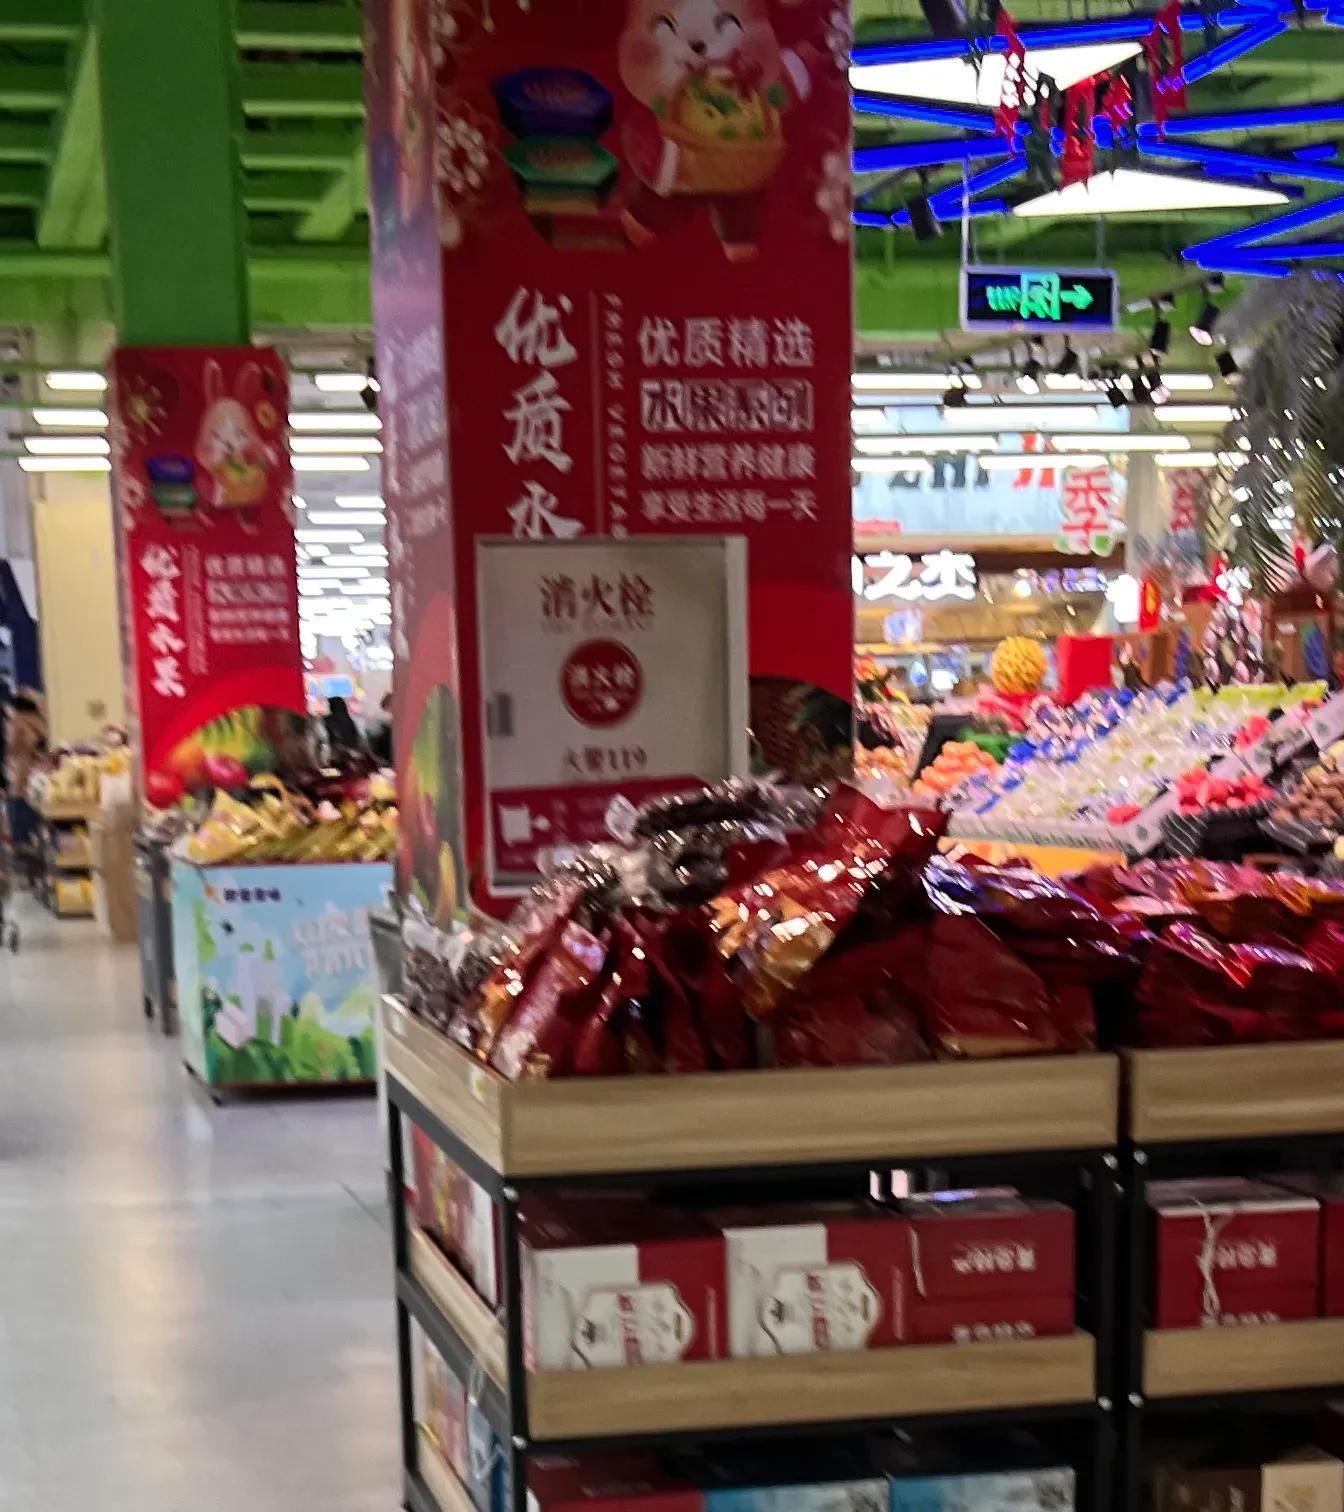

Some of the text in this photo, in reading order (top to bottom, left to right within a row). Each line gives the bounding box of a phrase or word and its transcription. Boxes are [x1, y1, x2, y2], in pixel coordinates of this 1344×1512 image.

[638, 315, 815, 368] 优质精选
[540, 570, 655, 619] 消火栓
